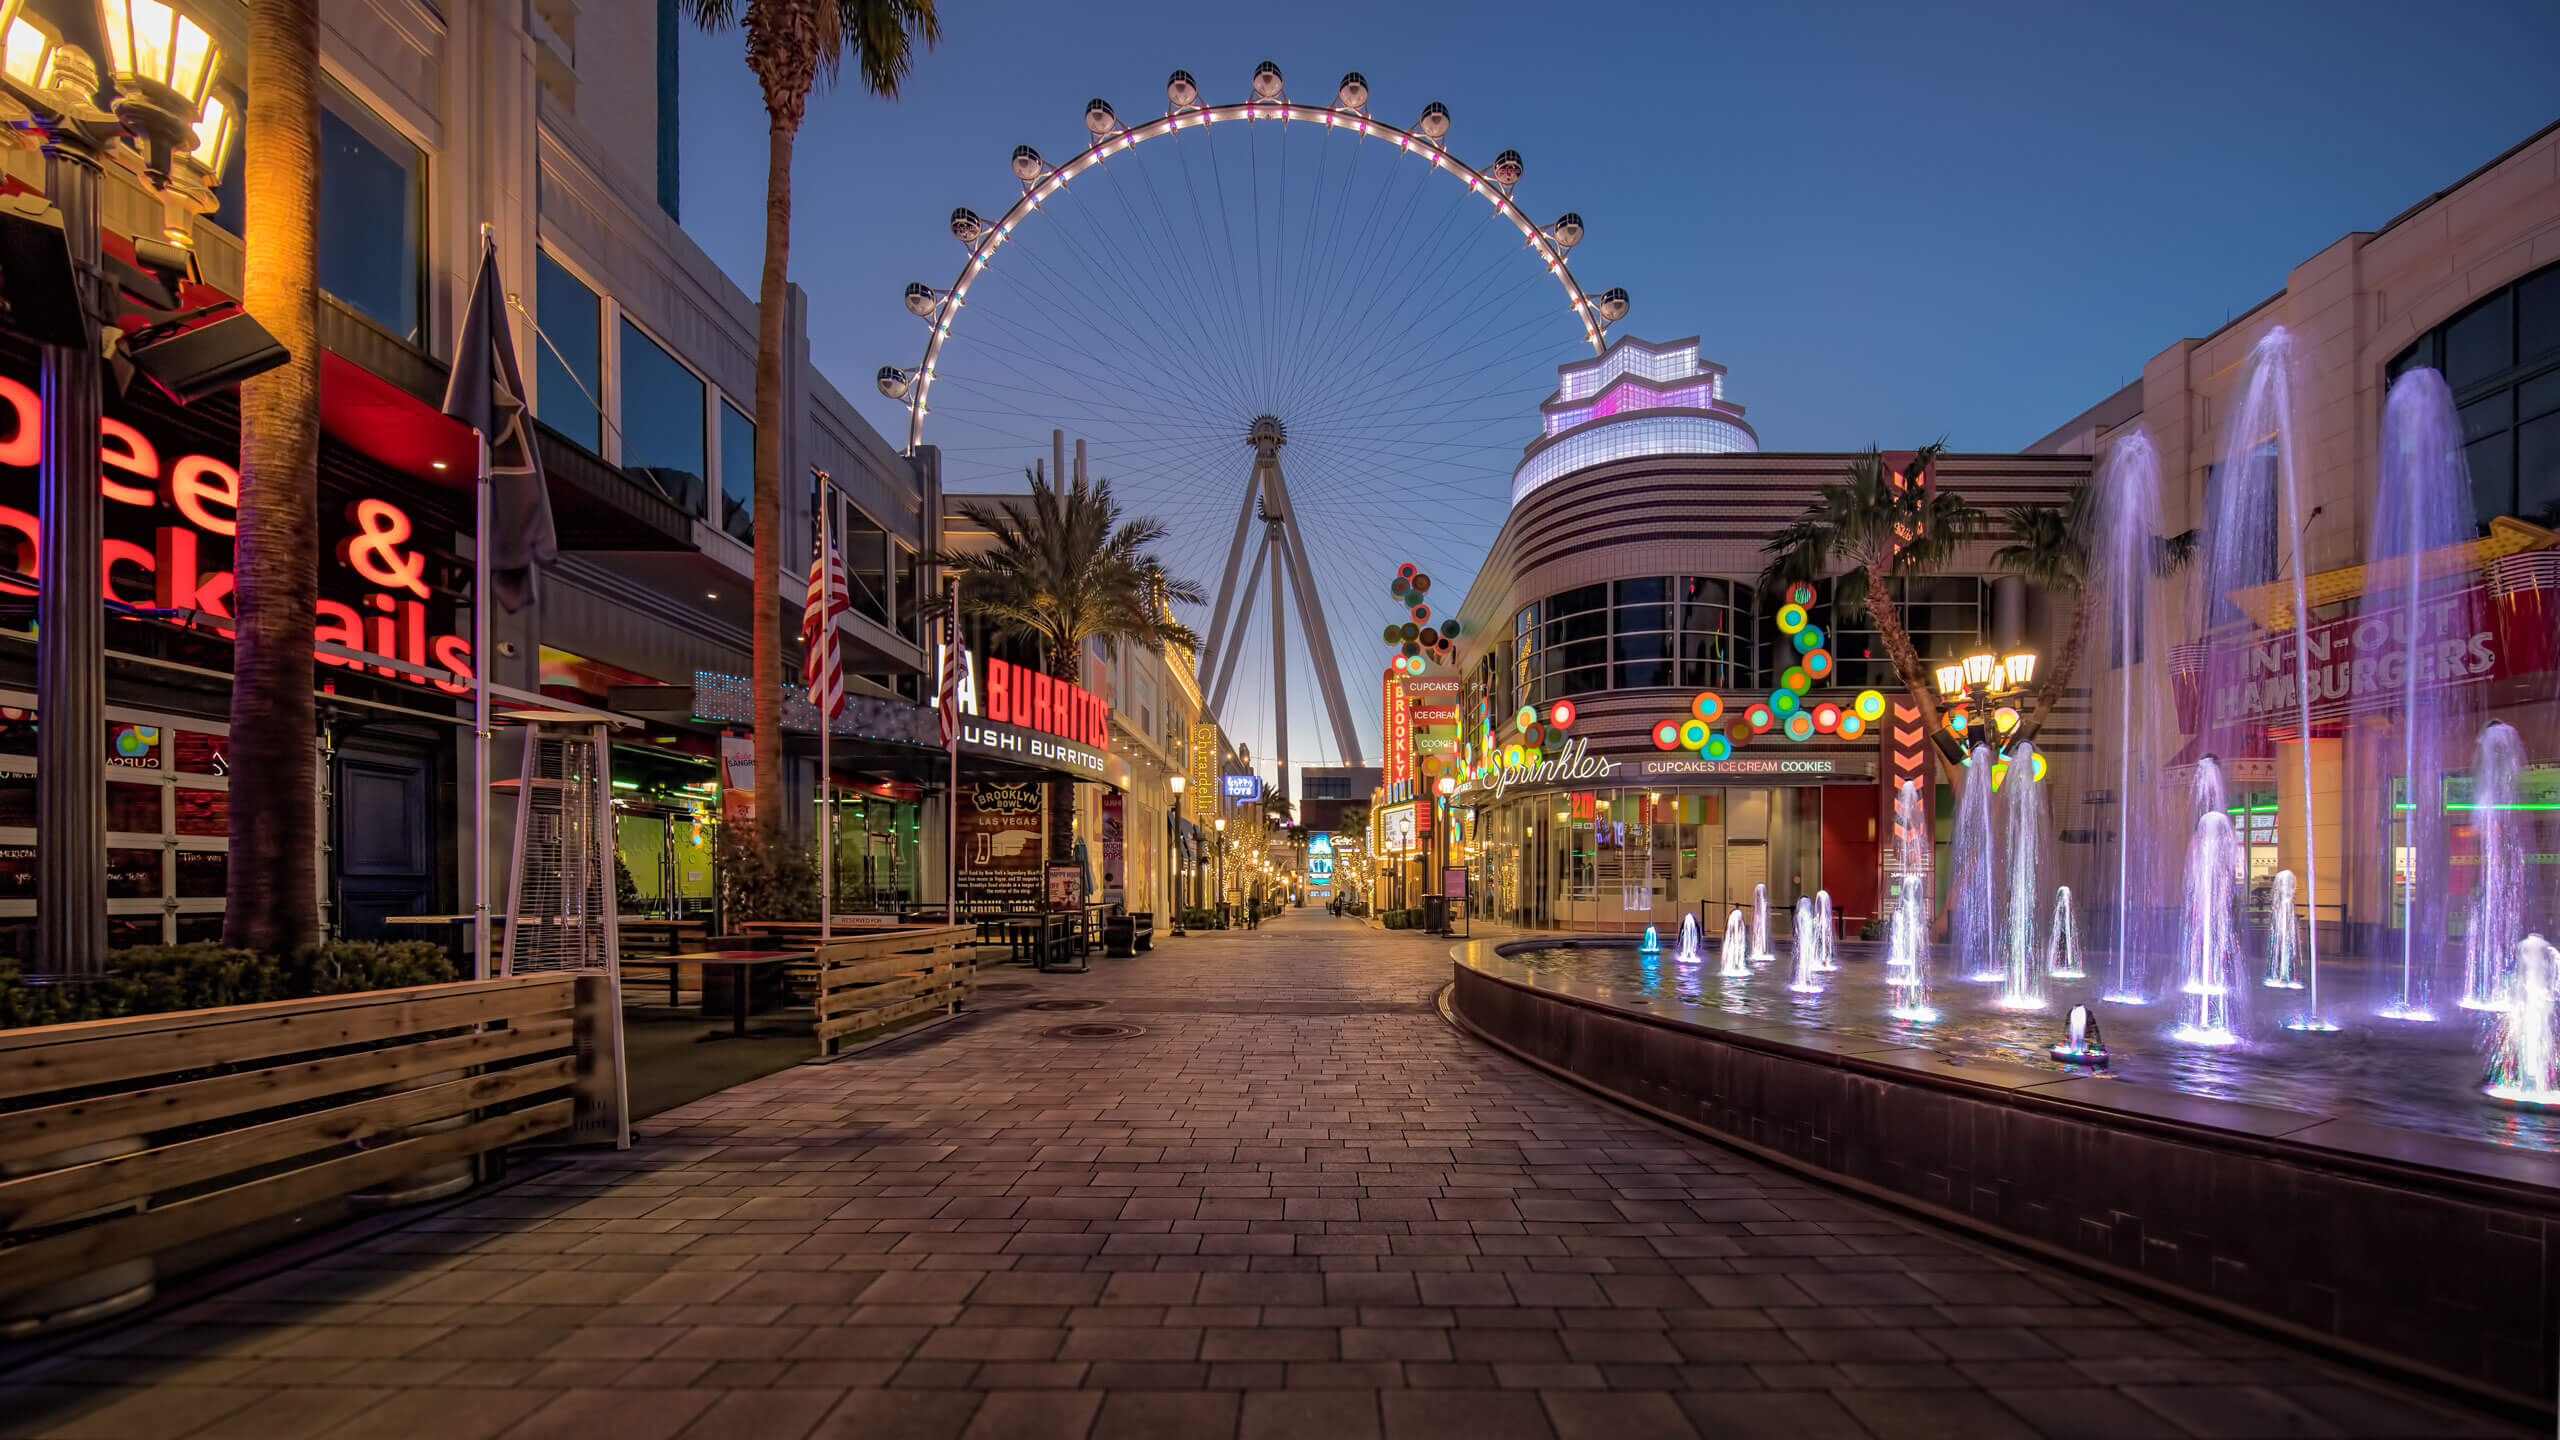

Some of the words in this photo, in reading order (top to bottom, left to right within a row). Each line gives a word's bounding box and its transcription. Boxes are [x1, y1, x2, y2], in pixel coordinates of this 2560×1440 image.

[0, 375, 240, 537] ee
[349, 499, 430, 598] &
[2237, 600, 2458, 680] IN-N-OUT
[2214, 631, 2495, 721] HAMBURGERS
[1409, 682, 1460, 691] CUPCAKES
[988, 657, 1109, 751] BURRITOS
[1414, 711, 1428, 719] ICE
[957, 725, 1022, 752] USHI
[1031, 739, 1104, 772] BURRITOS
[1421, 740, 1454, 748] COOKIE
[727, 760, 755, 768] SANGR
[1198, 727, 1213, 809] Ghirardelli
[1482, 737, 1622, 799] Sprinkles
[1648, 762, 1715, 773] CUPCAKES
[1718, 762, 1737, 772] ICE
[1737, 761, 1778, 772] CREAM
[1781, 761, 1832, 772] COOKIES
[977, 789, 1038, 805] BROOKLYN
[1228, 786, 1252, 795] TOYS
[997, 799, 1022, 808] BOWL
[979, 817, 999, 826] LAS
[1002, 817, 1038, 826] VEGAS
